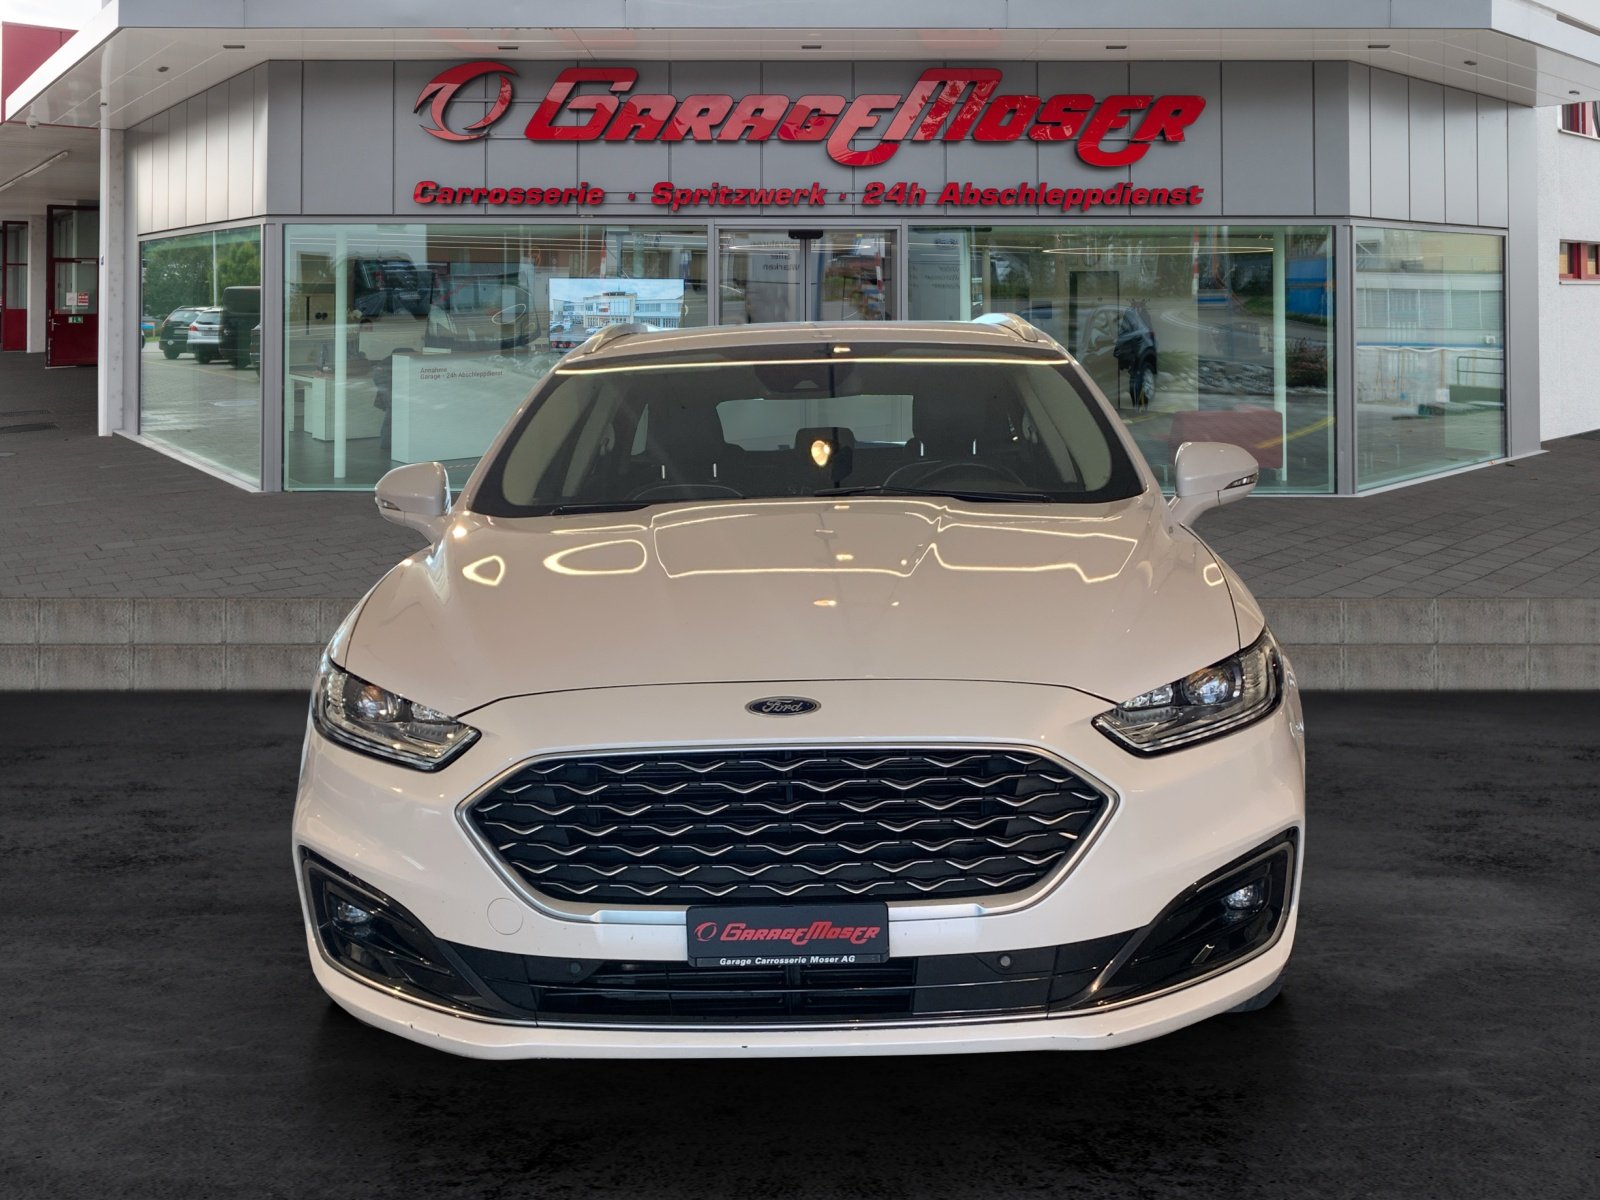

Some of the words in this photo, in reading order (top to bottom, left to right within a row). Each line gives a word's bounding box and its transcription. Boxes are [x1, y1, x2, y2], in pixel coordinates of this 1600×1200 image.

[412, 180, 605, 206] Carrosserie
[650, 181, 828, 212] Spritzwerk
[862, 181, 927, 206] 24h
[936, 181, 1204, 212] Abschleppdienst
[458, 370, 503, 378] Abschleppdienst
[762, 699, 804, 712] Ford
[720, 957, 752, 967] Garage
[755, 956, 807, 965] Carrosserie
[810, 956, 840, 964] Moser
[841, 955, 856, 963] AG
